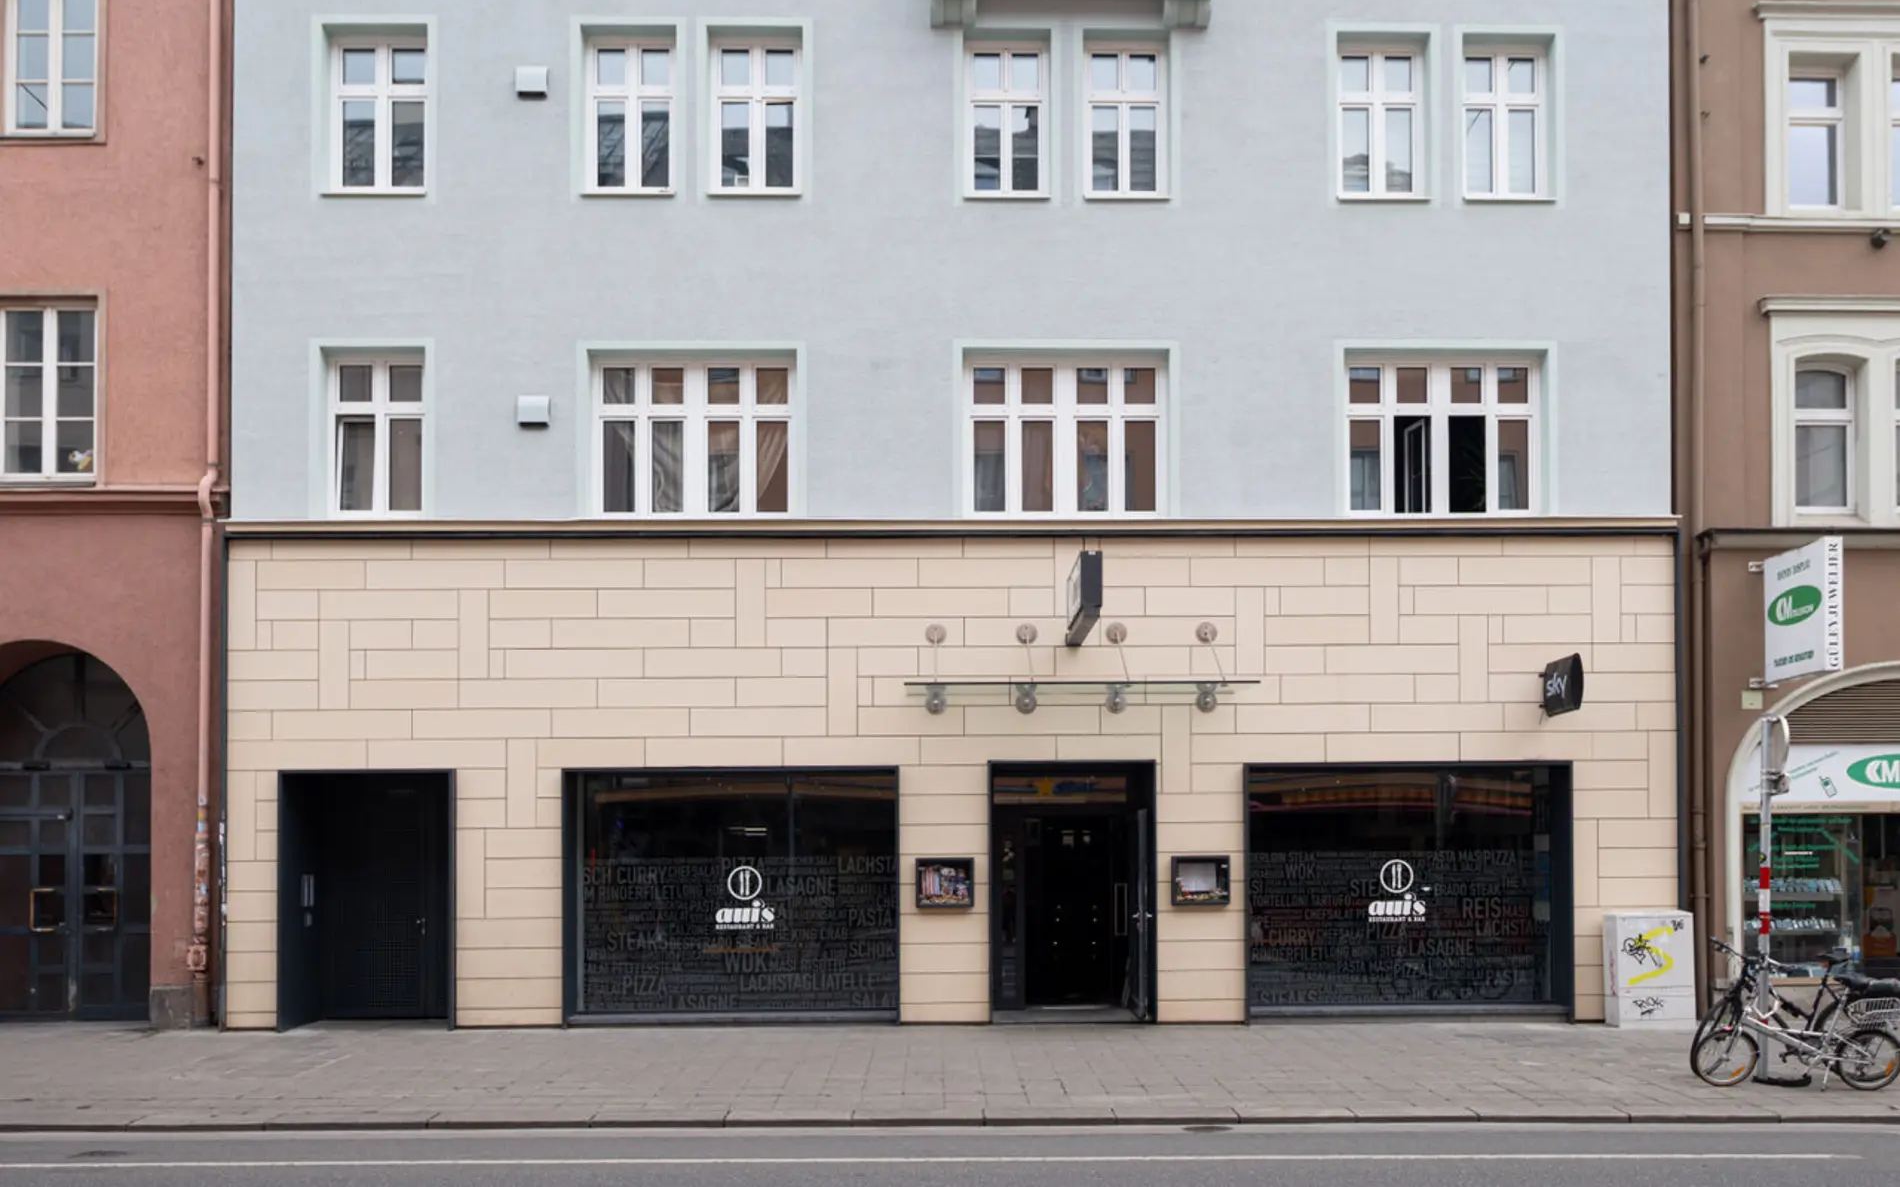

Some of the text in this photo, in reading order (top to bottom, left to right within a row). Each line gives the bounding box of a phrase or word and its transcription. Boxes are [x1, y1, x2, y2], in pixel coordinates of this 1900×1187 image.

[1546, 672, 1568, 698] sky
[1483, 851, 1516, 867] PIZZA
[617, 865, 669, 885] CURRY
[1285, 863, 1316, 880] WOK
[599, 885, 678, 901] RINDERFILET
[768, 875, 838, 896] LASAGNE
[848, 908, 894, 927] PASTA
[1462, 896, 1503, 919] REIS
[607, 930, 670, 952] STEAKS
[1408, 938, 1475, 956] LASAGNE
[725, 951, 768, 973] WOK
[623, 974, 669, 996] PIZZA
[740, 972, 875, 993] LACHSTAGLIATELLE
[668, 993, 739, 1010] LASAGNE
